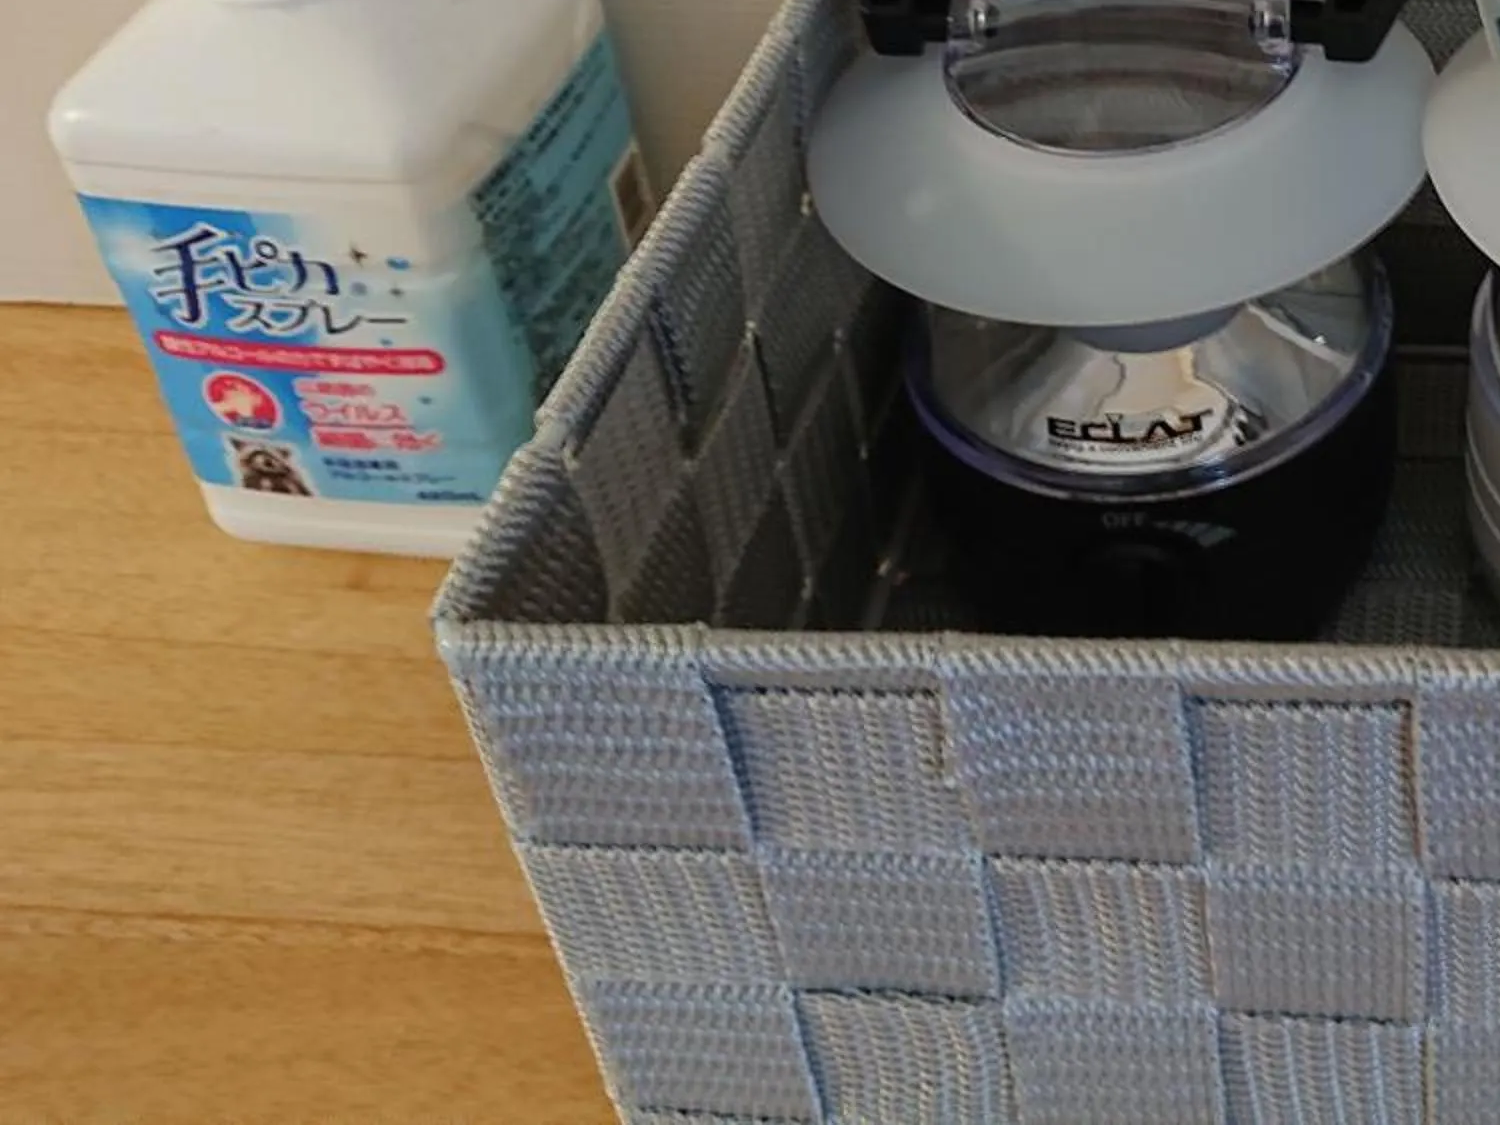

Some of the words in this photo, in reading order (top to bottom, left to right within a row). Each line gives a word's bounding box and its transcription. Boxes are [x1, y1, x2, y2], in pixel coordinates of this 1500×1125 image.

[150, 228, 340, 324] 手ピカ
[226, 298, 408, 335] スプレー
[1102, 511, 1148, 528] OFF
